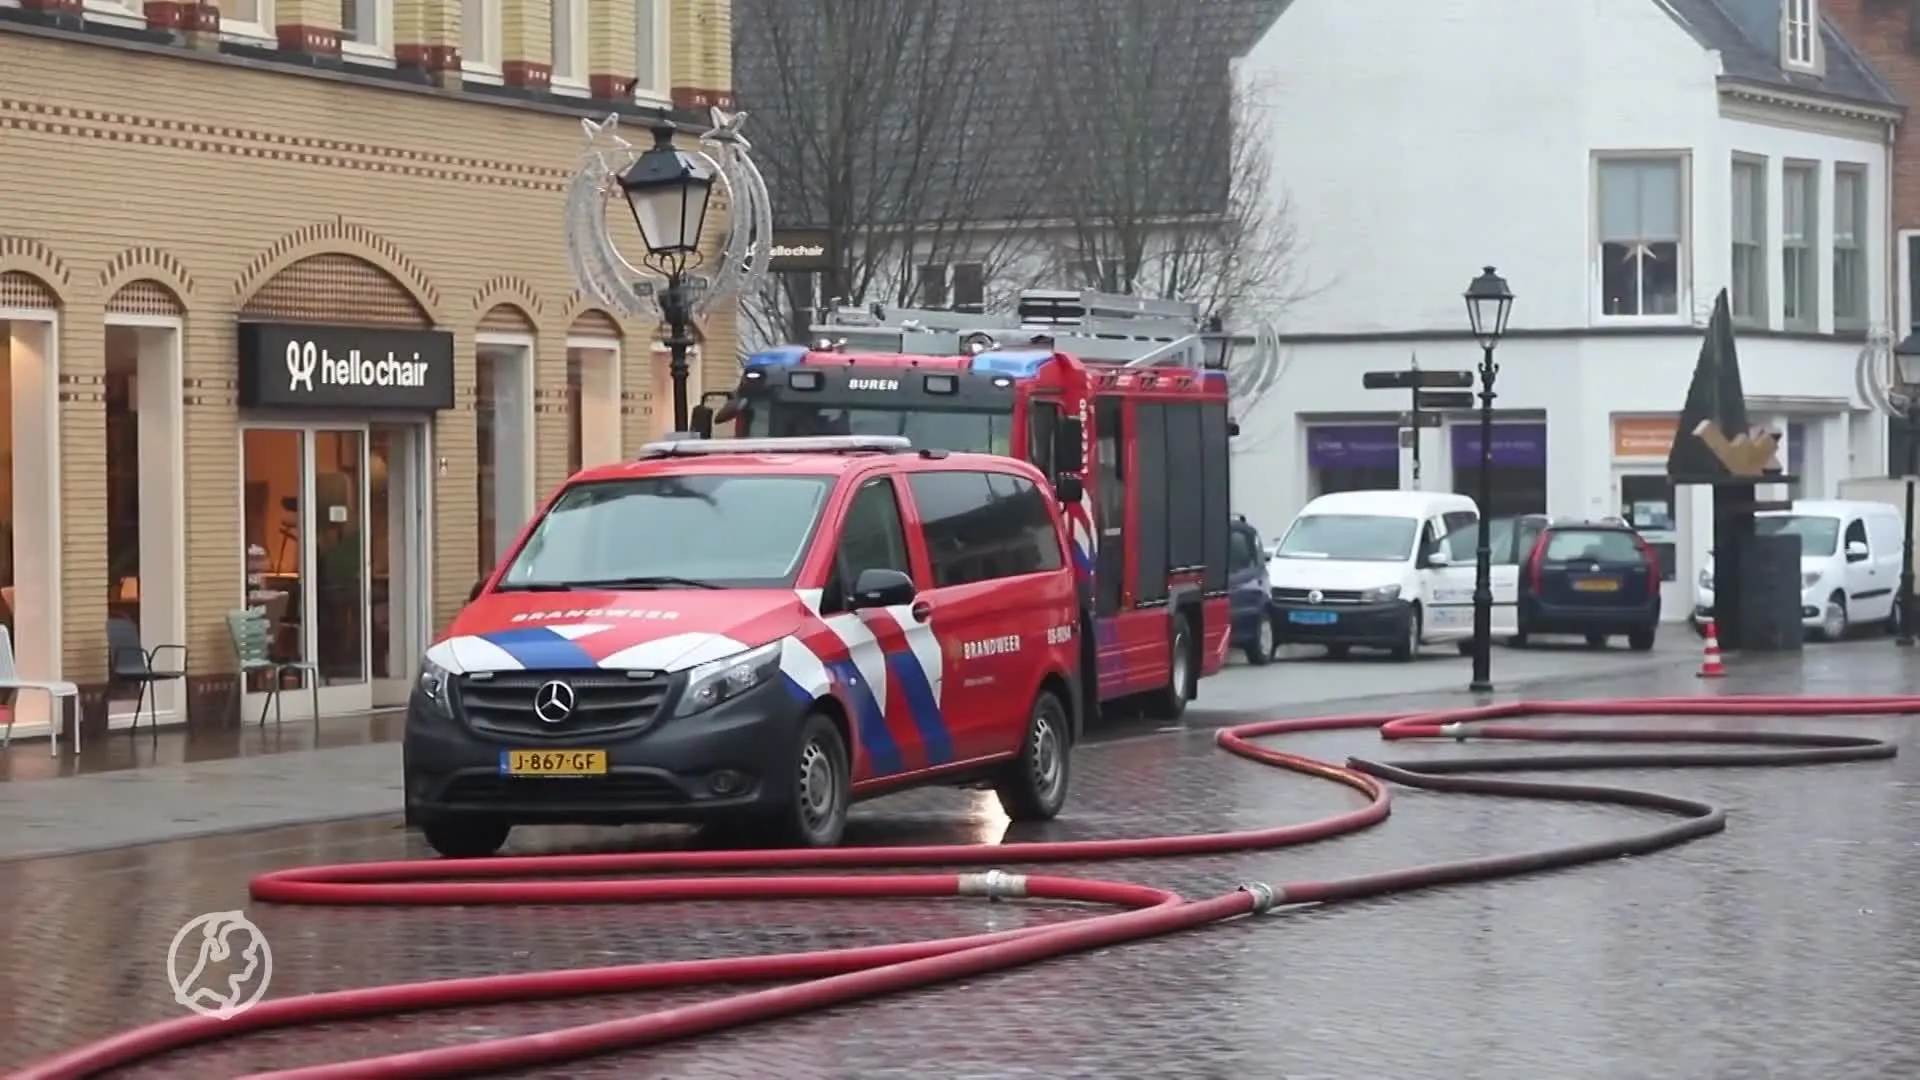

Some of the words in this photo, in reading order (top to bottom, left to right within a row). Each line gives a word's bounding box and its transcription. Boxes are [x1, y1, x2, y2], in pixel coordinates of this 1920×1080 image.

[764, 245, 825, 257] ellochair
[320, 348, 429, 387] hellochair
[848, 378, 900, 391] BUREN
[511, 608, 680, 622] BRANDWEER
[963, 634, 1021, 660] BRANDWEER
[515, 753, 597, 770] J-867-GF
